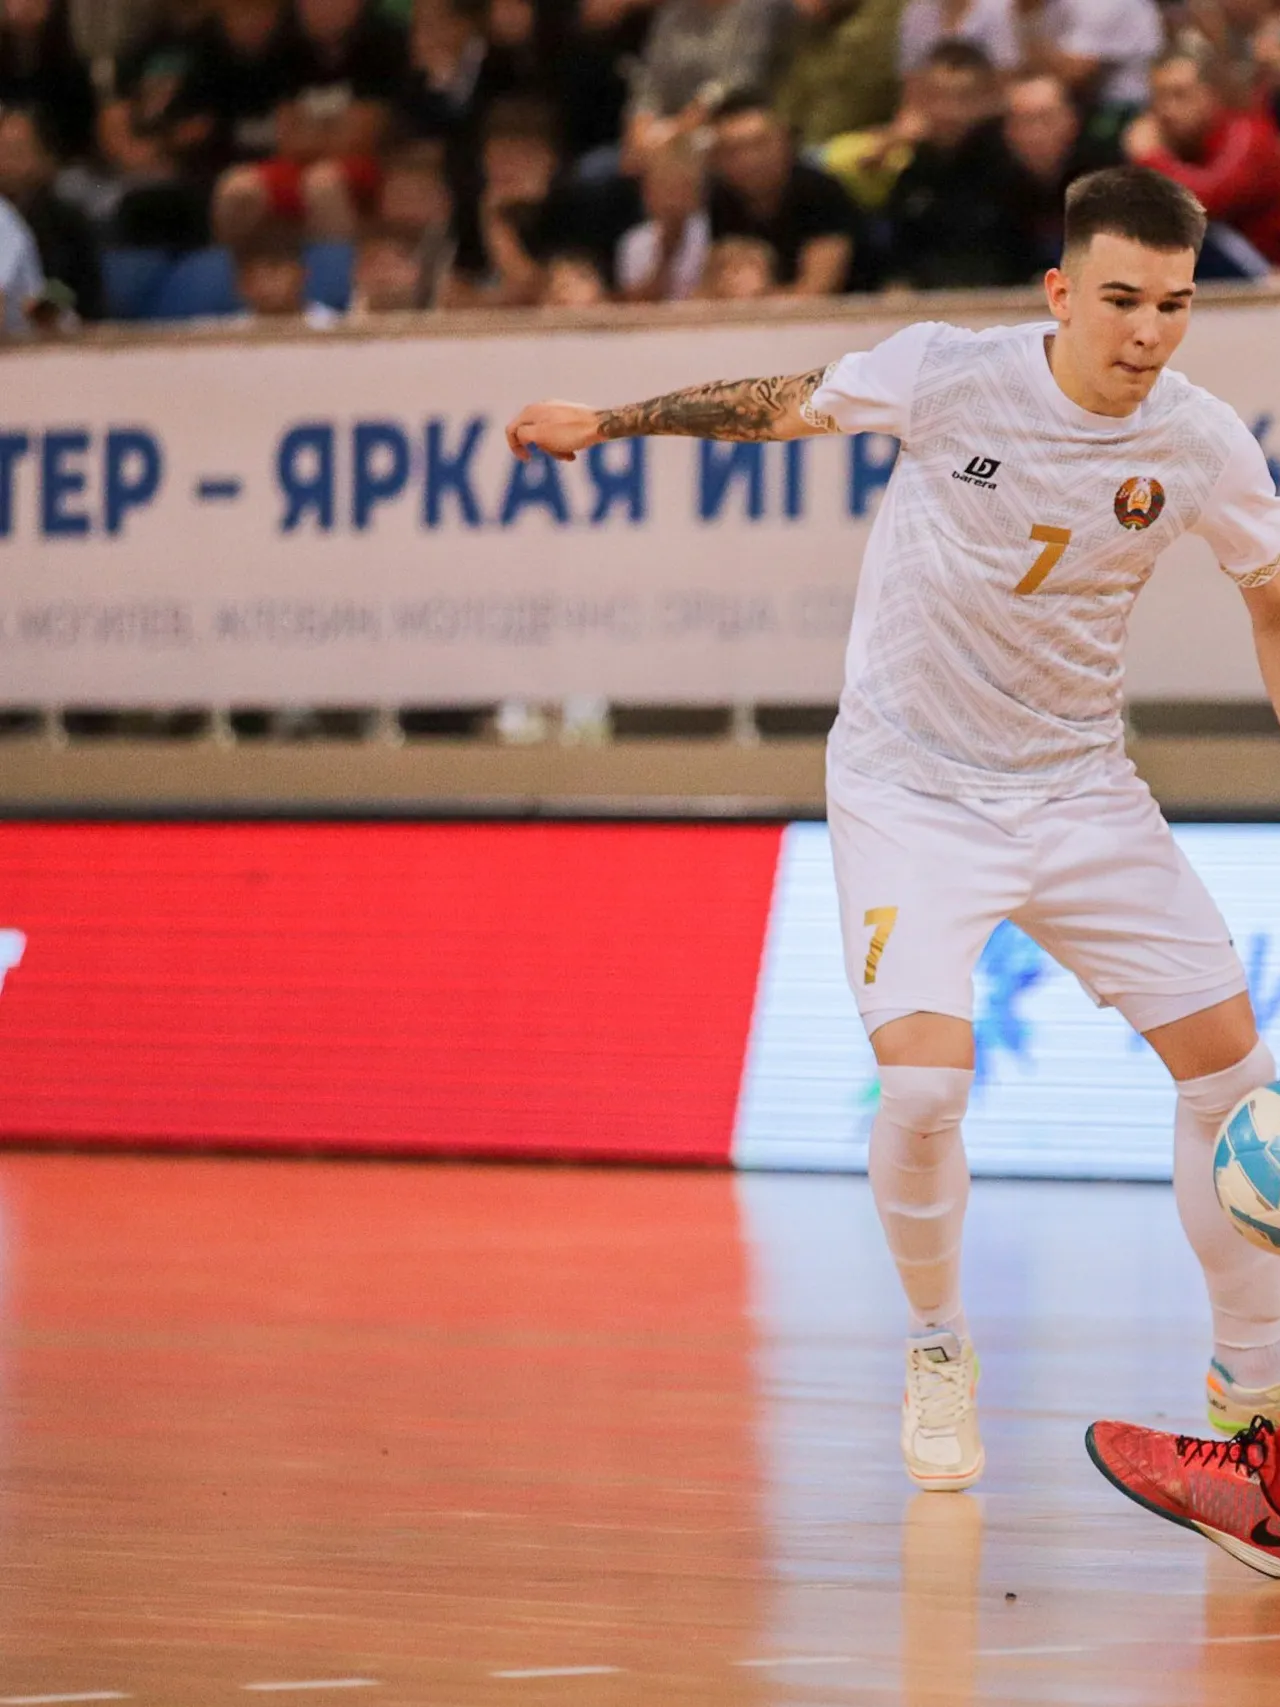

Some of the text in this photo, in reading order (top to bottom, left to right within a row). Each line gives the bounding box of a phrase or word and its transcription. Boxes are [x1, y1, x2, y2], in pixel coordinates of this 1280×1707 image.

[276, 418, 646, 532] ЯРКАЯ
[697, 431, 901, 522] ИГР
[951, 470, 998, 490] barera
[1013, 523, 1071, 596] 7
[863, 905, 899, 985] 7
